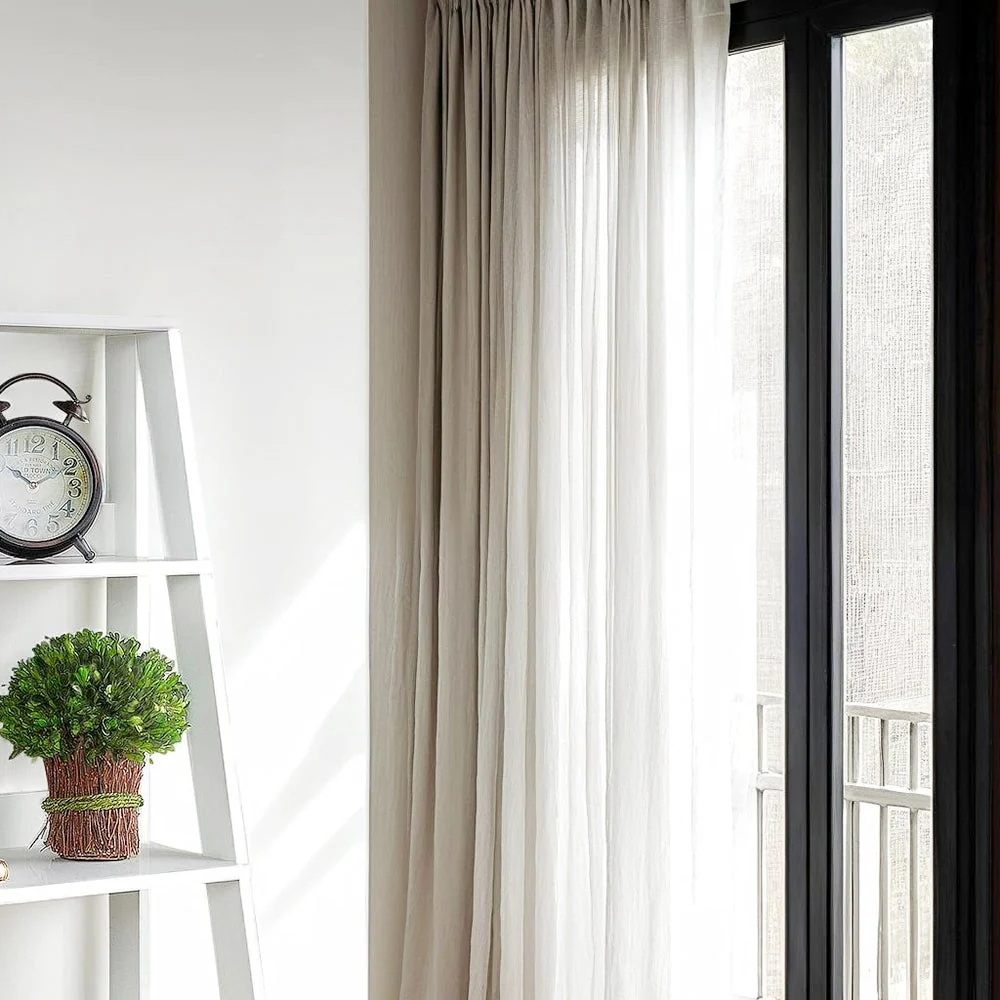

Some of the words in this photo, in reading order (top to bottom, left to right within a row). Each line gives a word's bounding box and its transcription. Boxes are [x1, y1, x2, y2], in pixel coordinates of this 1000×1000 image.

[5, 438, 18, 456] 11
[23, 435, 45, 453] 12
[51, 441, 60, 460] 1
[63, 457, 77, 475] 2
[68, 478, 82, 498] 3
[59, 499, 75, 518] 4
[26, 518, 38, 537] 6
[46, 514, 60, 533] 5
